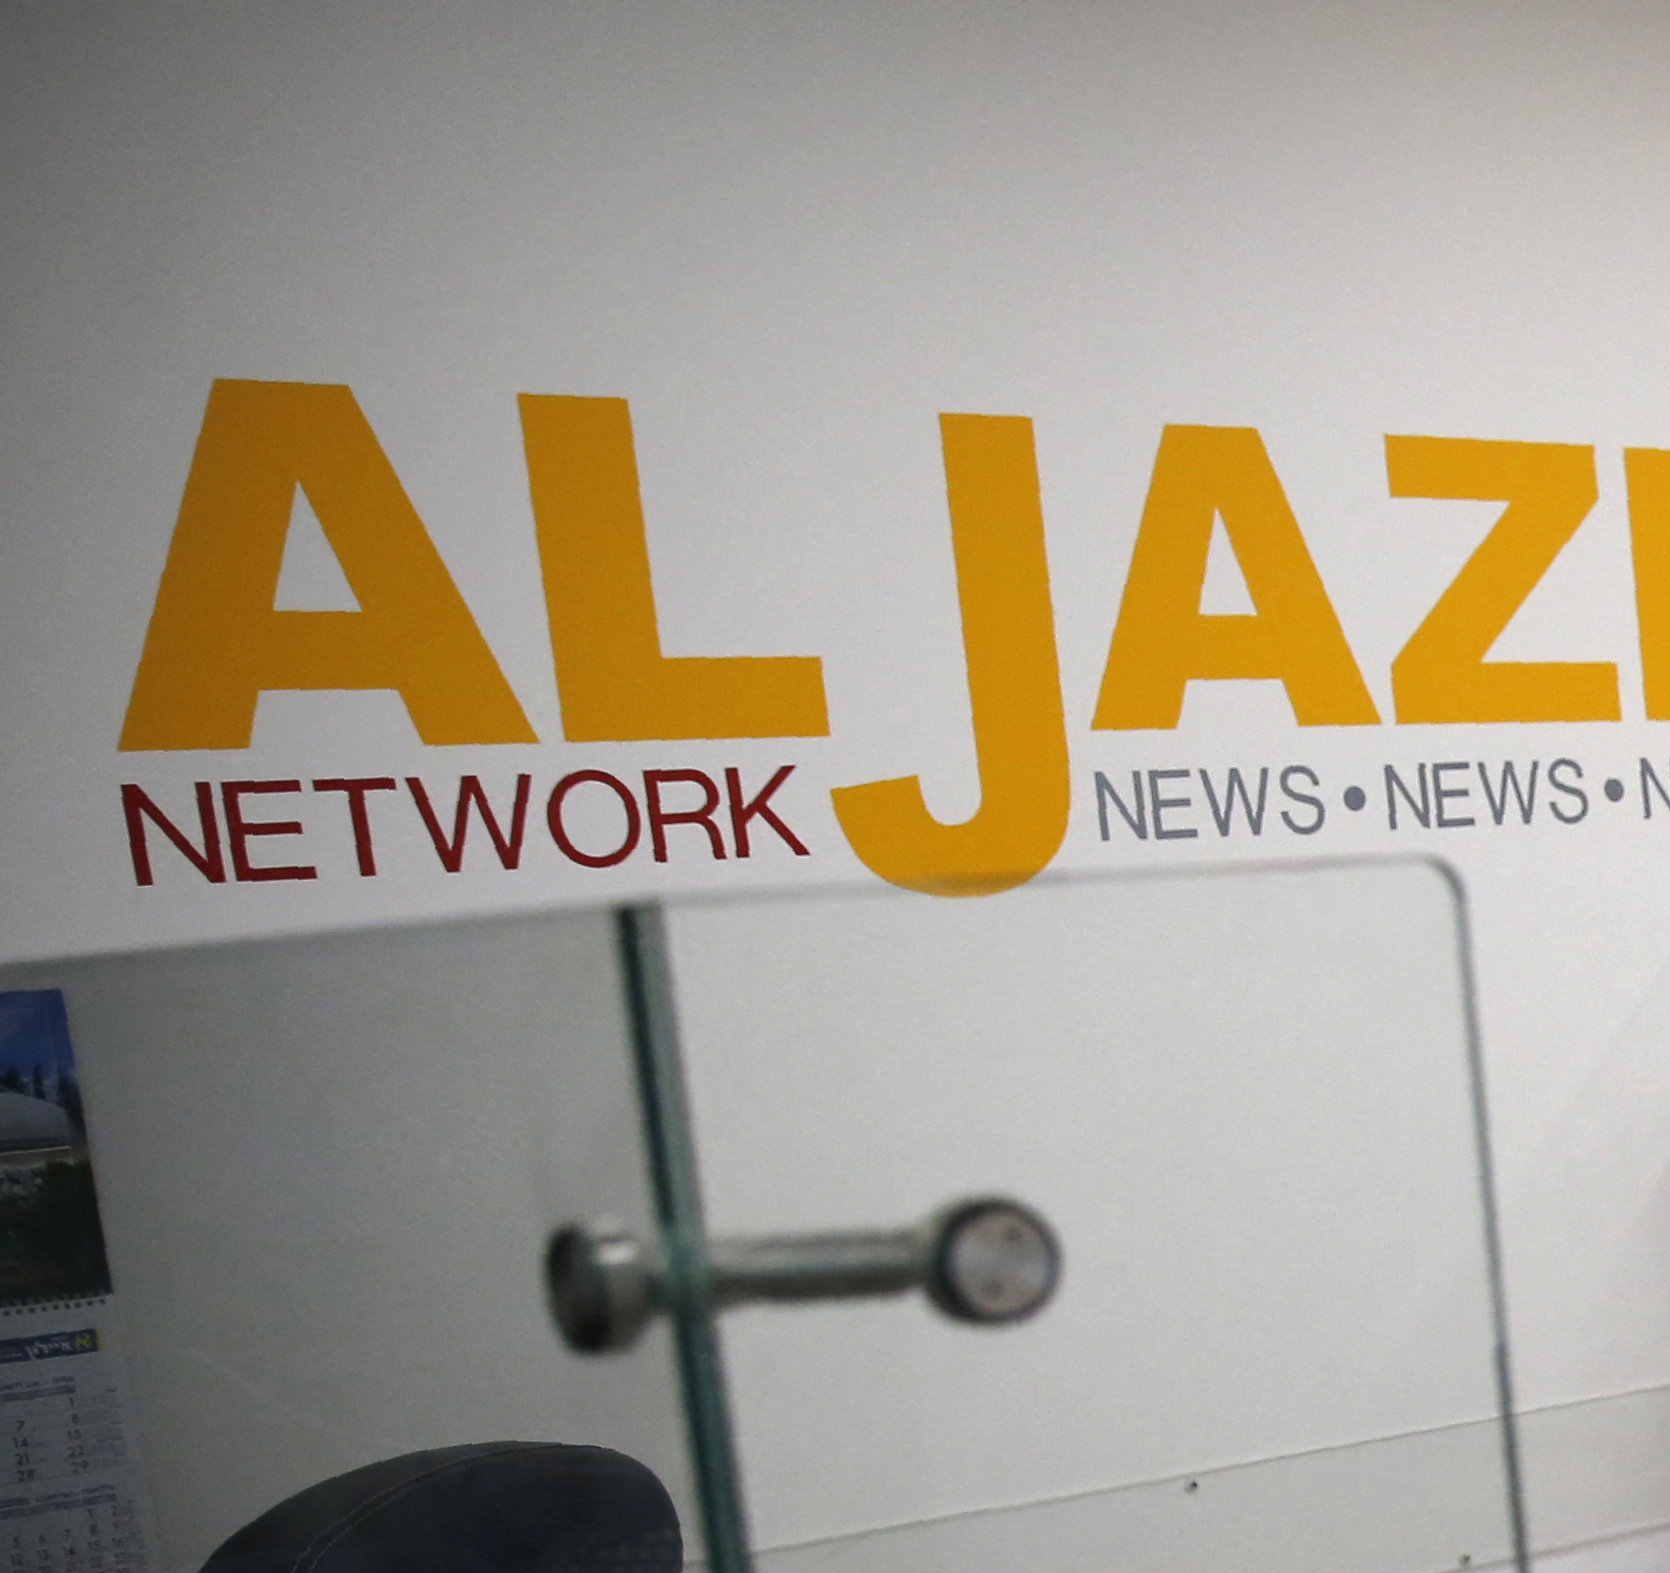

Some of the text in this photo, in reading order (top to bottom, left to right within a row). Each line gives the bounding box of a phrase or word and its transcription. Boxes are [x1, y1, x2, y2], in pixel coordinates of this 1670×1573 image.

[118, 377, 831, 752] AL
[120, 765, 812, 887] NETWORK
[1094, 765, 1326, 842] NEWS
[1383, 757, 1589, 831] NEWS
[11, 1428, 82, 1449] 14 15
[13, 1451, 30, 1466] 21
[15, 1467, 35, 1482] 28
